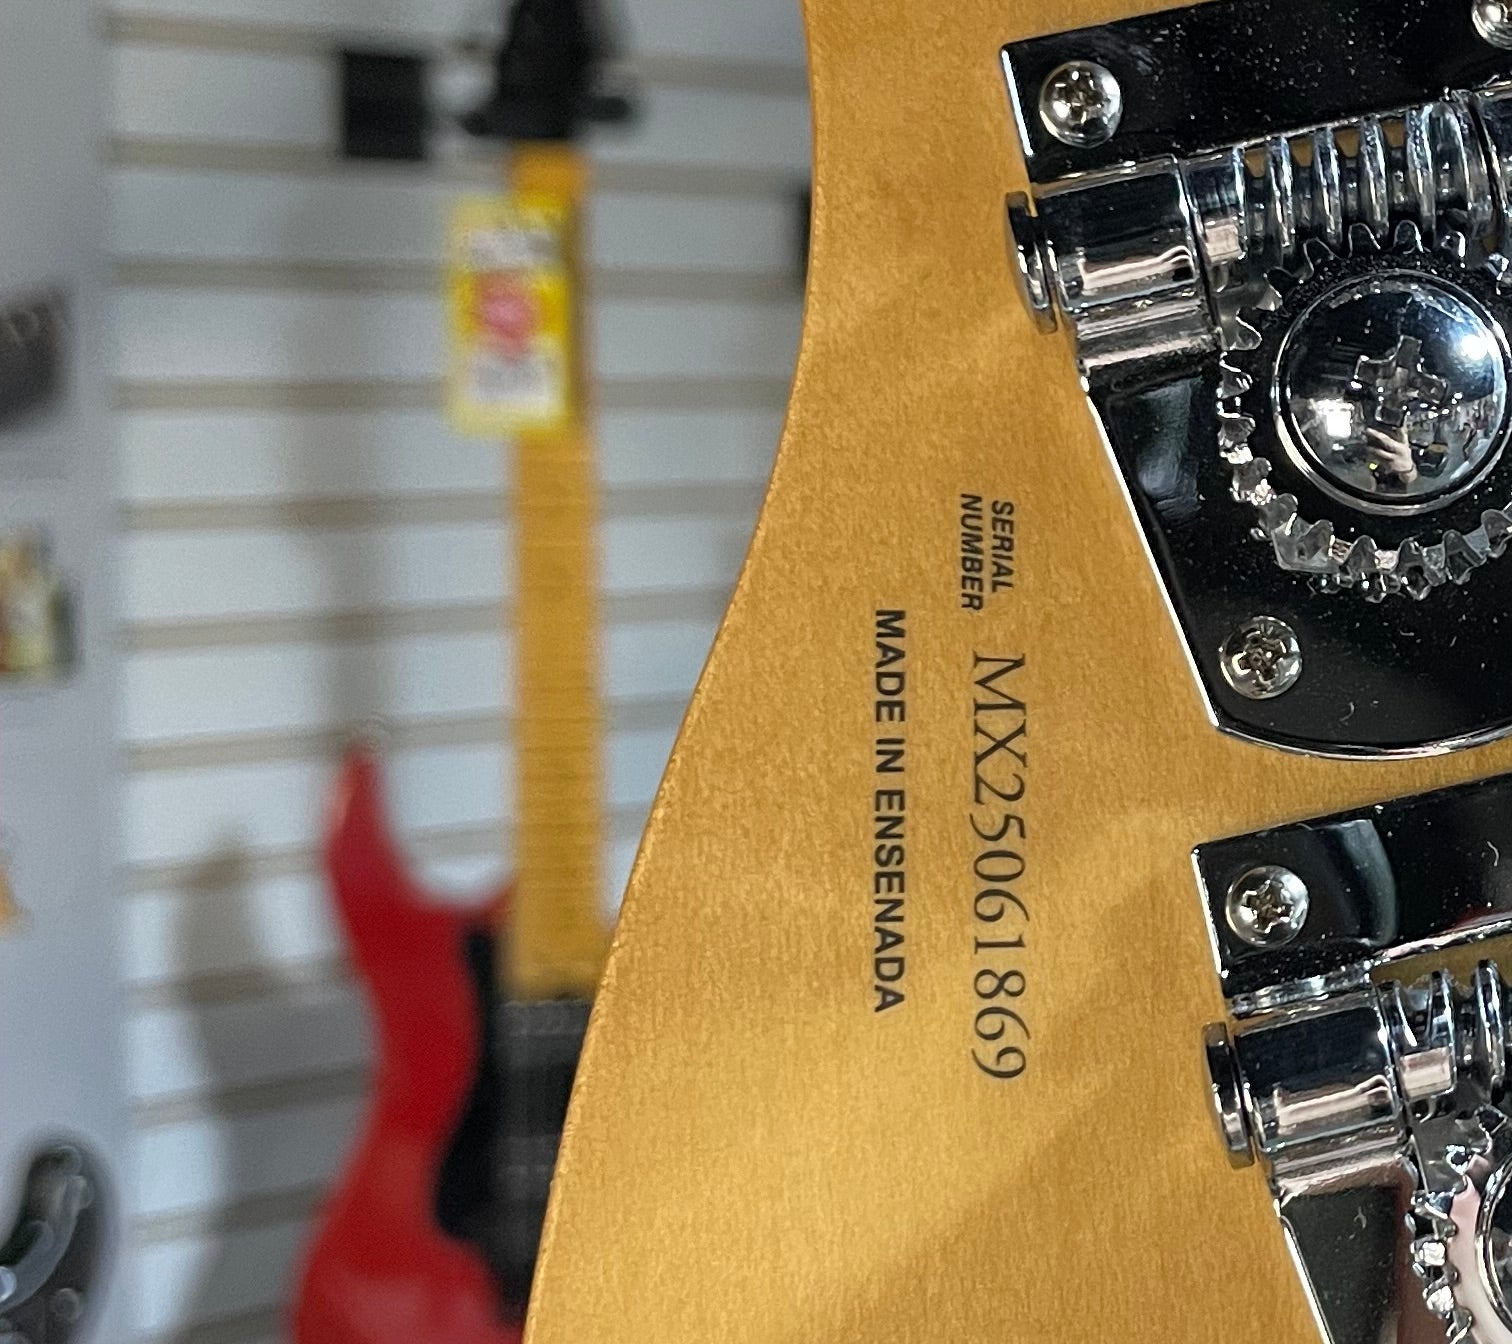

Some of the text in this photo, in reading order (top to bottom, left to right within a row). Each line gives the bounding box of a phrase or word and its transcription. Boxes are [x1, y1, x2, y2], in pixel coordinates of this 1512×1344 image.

[960, 492, 984, 612] NUMBER
[990, 499, 1015, 594] SERIAL
[873, 608, 906, 1014] MADE IN ENSENADA
[969, 650, 1031, 1080] MX25061869
